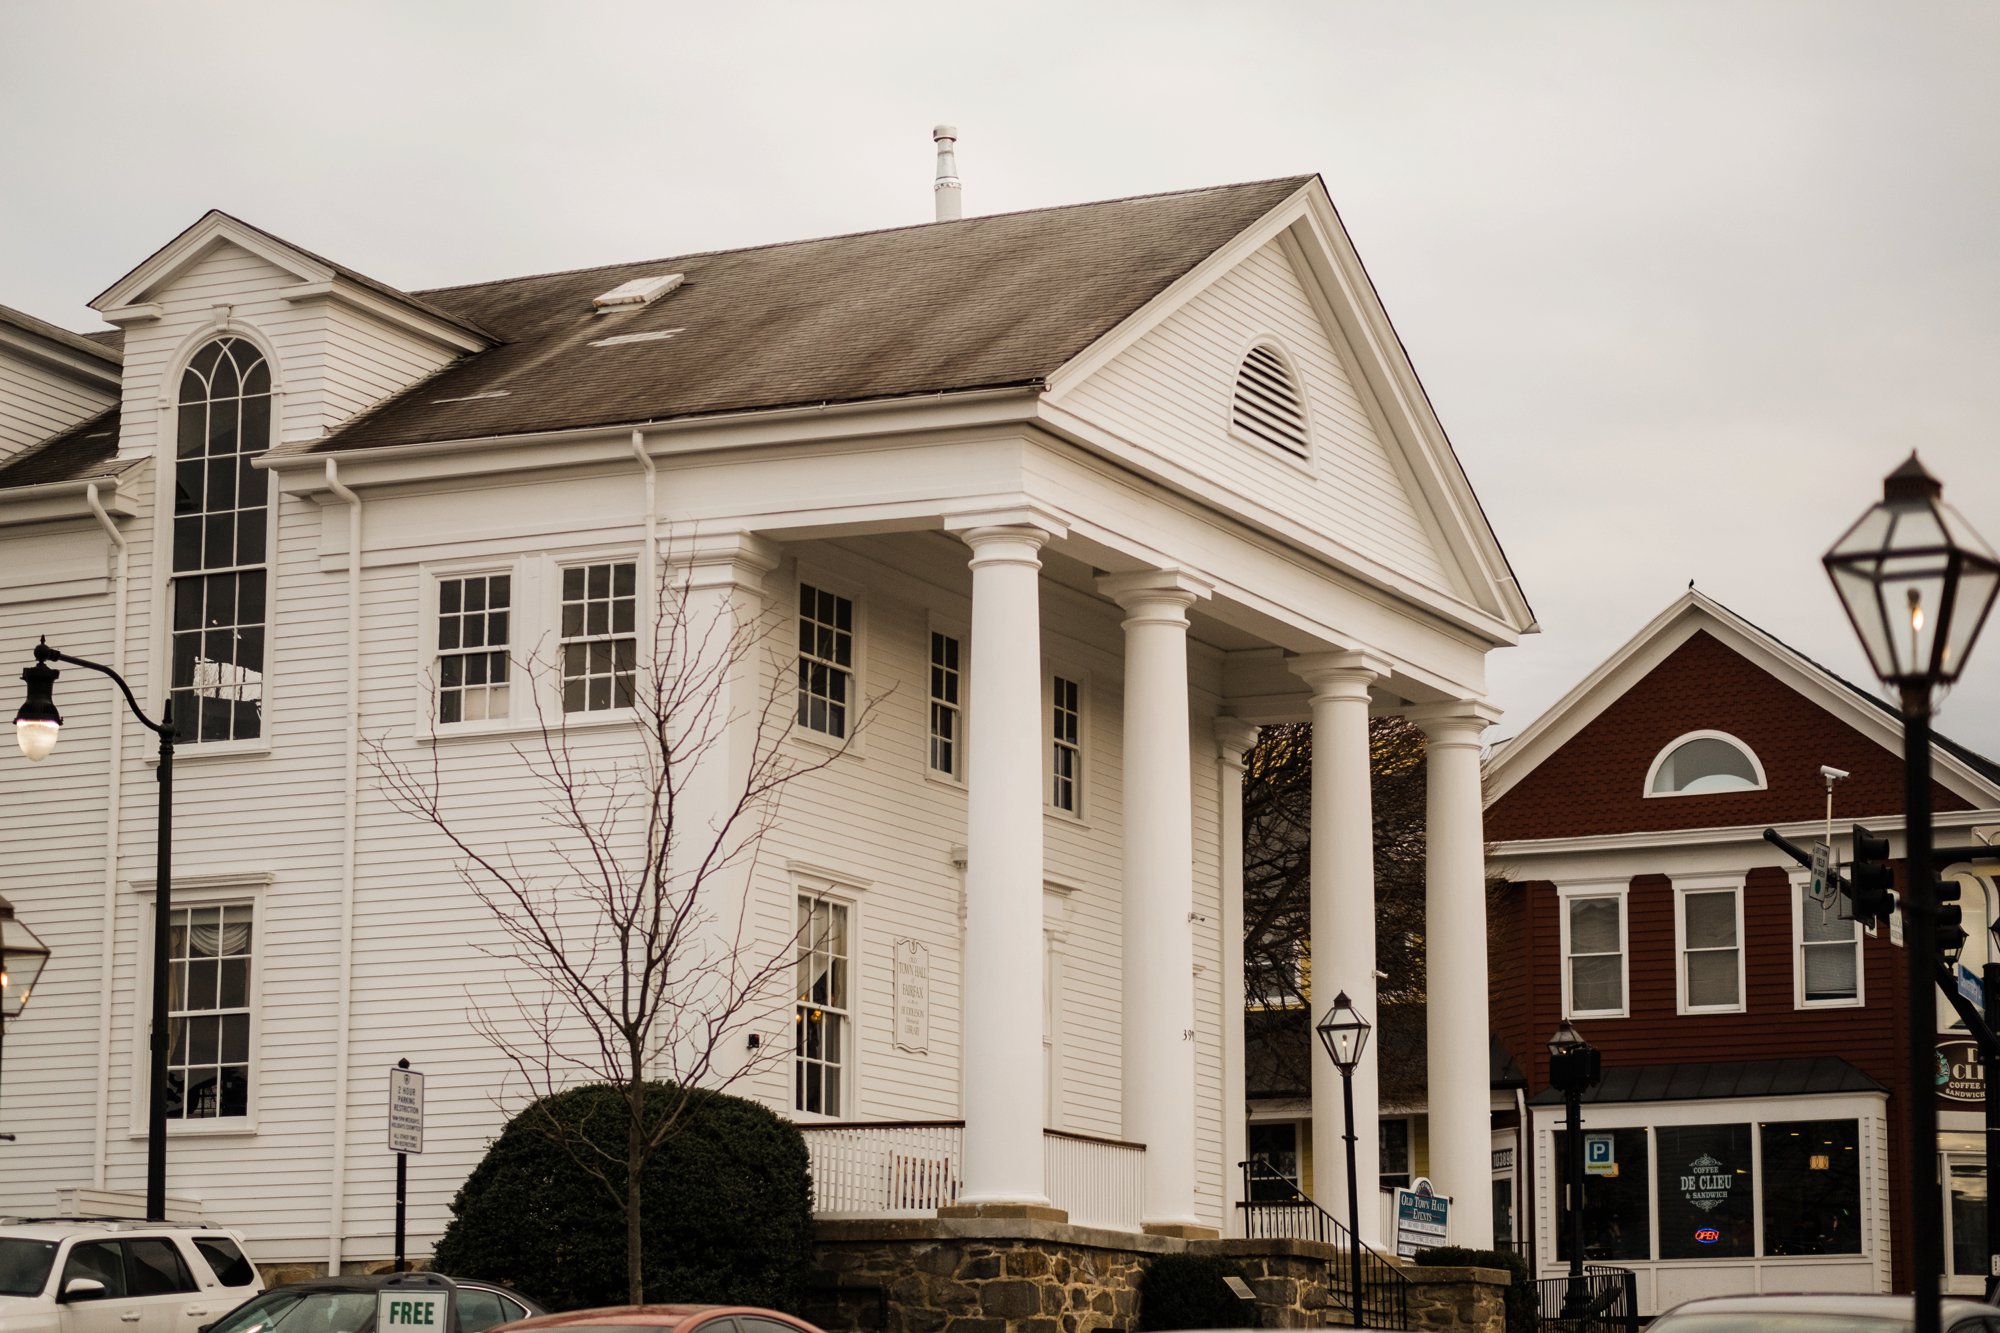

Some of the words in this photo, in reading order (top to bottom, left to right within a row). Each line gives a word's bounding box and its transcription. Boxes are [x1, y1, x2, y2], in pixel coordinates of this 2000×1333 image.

[899, 962, 914, 976] TOWN
[914, 965, 927, 979] HALL
[902, 984, 924, 999] FAIRFAX
[1952, 1063, 1984, 1080] CLI
[1949, 1081, 1981, 1090] COFFEE
[402, 1087, 416, 1096] HOUR
[398, 1095, 415, 1105] PARKING
[394, 1104, 419, 1114] RESTRICTION
[1693, 1166, 1719, 1174] COFFEE
[1680, 1176, 1696, 1190] DE
[1700, 1175, 1732, 1190] CLIEU
[1692, 1191, 1728, 1199] SANDWICH
[1695, 1231, 1719, 1240] OPEN
[389, 1301, 435, 1325] FREE
